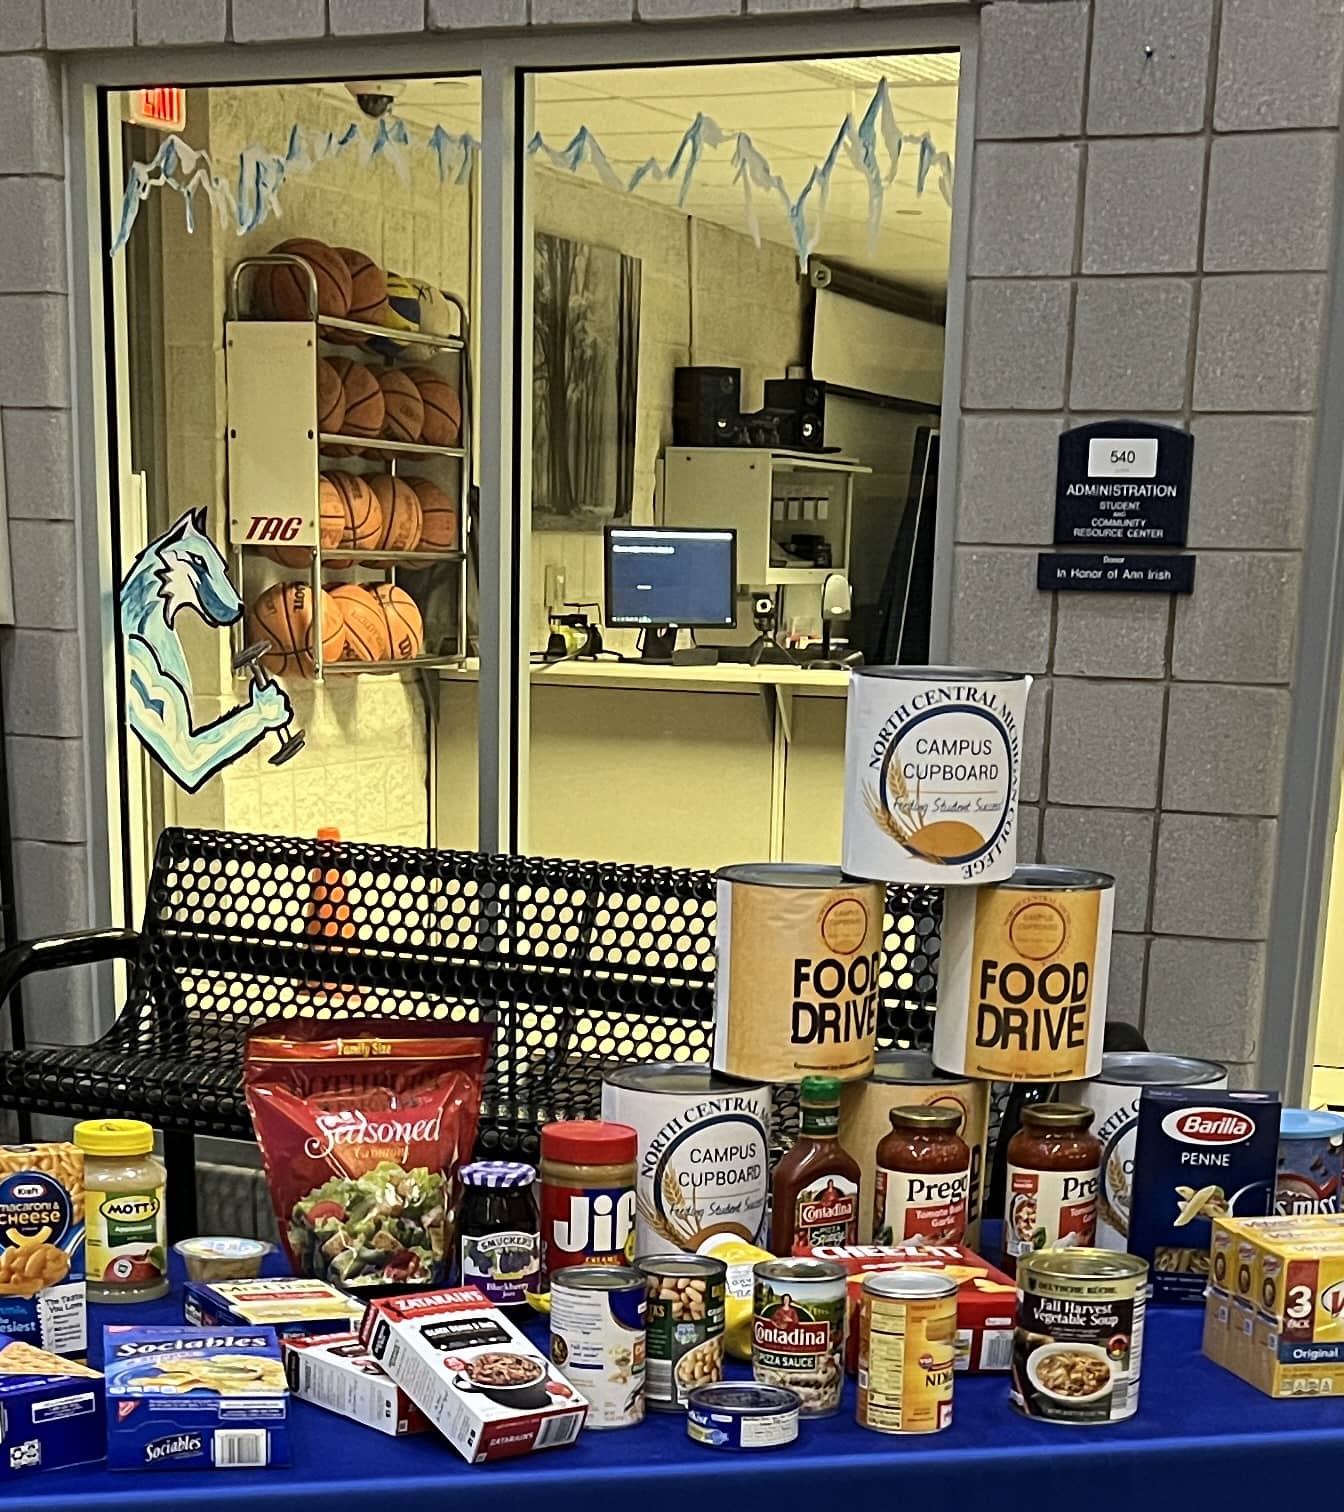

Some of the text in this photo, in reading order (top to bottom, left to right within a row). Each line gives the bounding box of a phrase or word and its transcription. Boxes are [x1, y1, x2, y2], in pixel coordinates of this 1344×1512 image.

[1110, 450, 1136, 464] 540
[1066, 484, 1177, 497] ADMINISTRATION
[1099, 501, 1141, 511] STUDENT
[246, 516, 302, 541] TAG
[1091, 518, 1147, 528] COMMUNITY
[1073, 528, 1164, 538] RESOURCE CENTER
[1057, 569, 1172, 580] In Honor of Ann Irish
[869, 686, 997, 771] NORTH CENTRAL
[916, 738, 992, 756] CAMPUS
[903, 763, 998, 781] CUPBOARD
[794, 951, 880, 999] FOOD
[980, 960, 1089, 1004] FOOD
[791, 992, 878, 1044] DRIVE
[976, 1003, 1086, 1051] DRIVE
[372, 1041, 392, 1055] Size
[1182, 1116, 1246, 1135] Barilla
[305, 1107, 444, 1164] Seasoned
[642, 1097, 761, 1178] NORTH CENTRAL
[690, 1143, 757, 1164] CAMPUS
[1181, 1152, 1231, 1167] PENNE
[678, 1165, 761, 1187] CUPBOARD
[17, 1187, 39, 1196] Kraft
[802, 1203, 853, 1223] Contadina
[554, 1195, 637, 1253] Jif
[395, 1288, 484, 1310] ZATARAIN'S
[1039, 1299, 1114, 1315] Fall Harvest
[1287, 1286, 1313, 1318] 3
[1033, 1309, 1120, 1328] Vegetable Soup
[1287, 1318, 1312, 1330] PACK
[755, 1323, 826, 1346] Contadina
[116, 1336, 268, 1358] Sociables
[1292, 1348, 1340, 1361] Original
[758, 1354, 814, 1368] PIZZA SAUCE
[145, 1435, 202, 1463] Sociables
